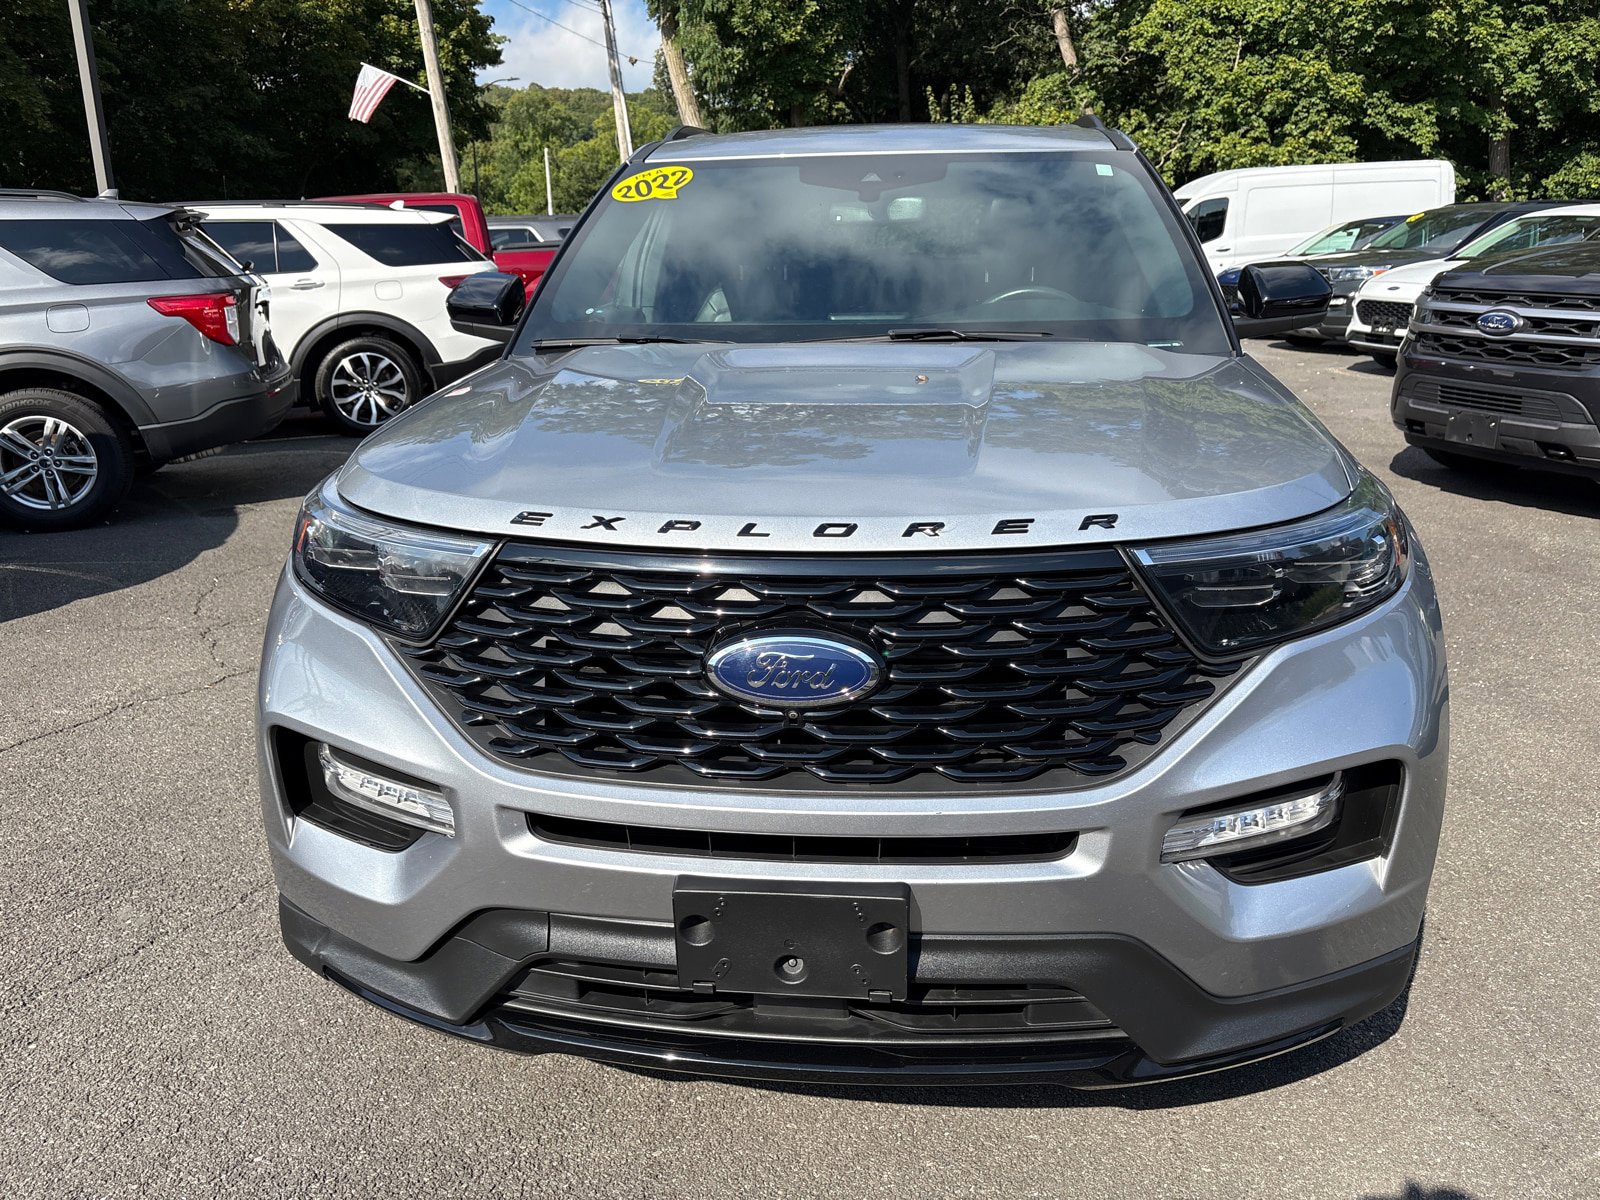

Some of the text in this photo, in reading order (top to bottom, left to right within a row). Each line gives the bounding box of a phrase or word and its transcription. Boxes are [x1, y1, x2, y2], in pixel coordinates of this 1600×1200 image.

[617, 170, 688, 199] 2022
[510, 510, 1119, 538] EXPLORER
[746, 651, 837, 690] Ford
